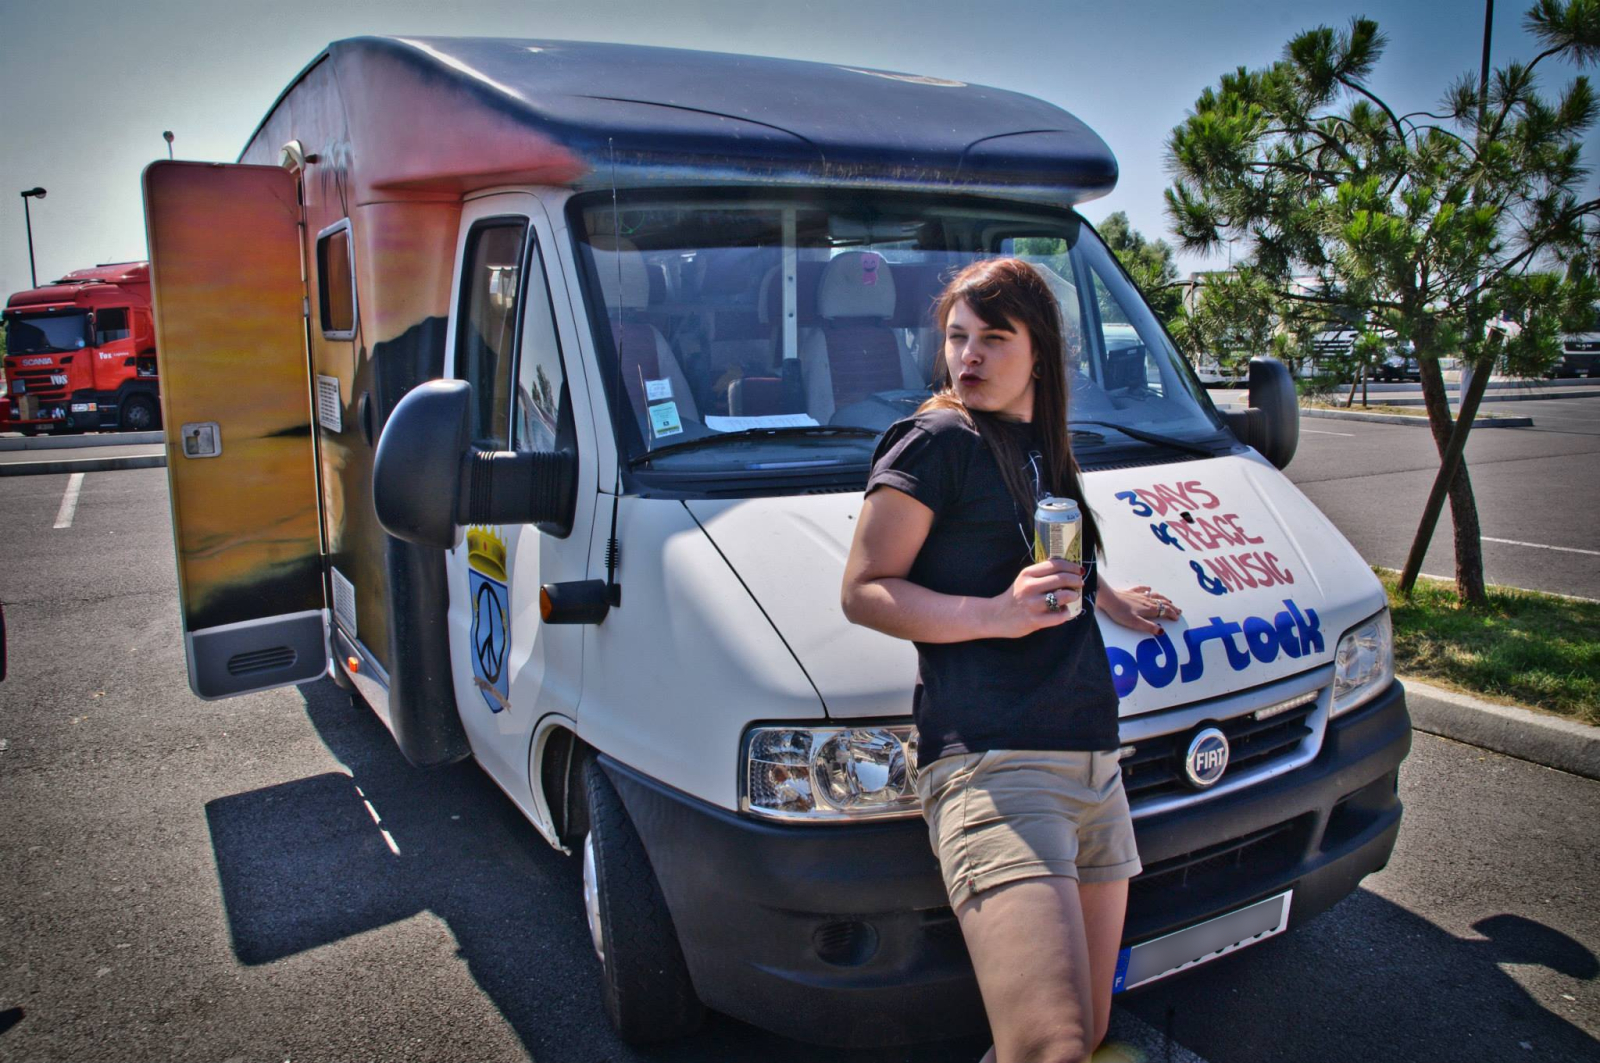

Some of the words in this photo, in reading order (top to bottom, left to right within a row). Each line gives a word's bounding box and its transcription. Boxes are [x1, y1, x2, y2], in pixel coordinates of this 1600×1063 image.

[22, 358, 53, 366] SCANIA
[1114, 490, 1153, 518] 3
[1133, 480, 1221, 517] DAYS
[1167, 513, 1264, 551] PEACE
[1189, 559, 1227, 596] &
[1203, 551, 1295, 593] MUSIC
[1106, 599, 1325, 698] odstock
[1196, 747, 1224, 772] FIAT
[1115, 976, 1123, 988] F
